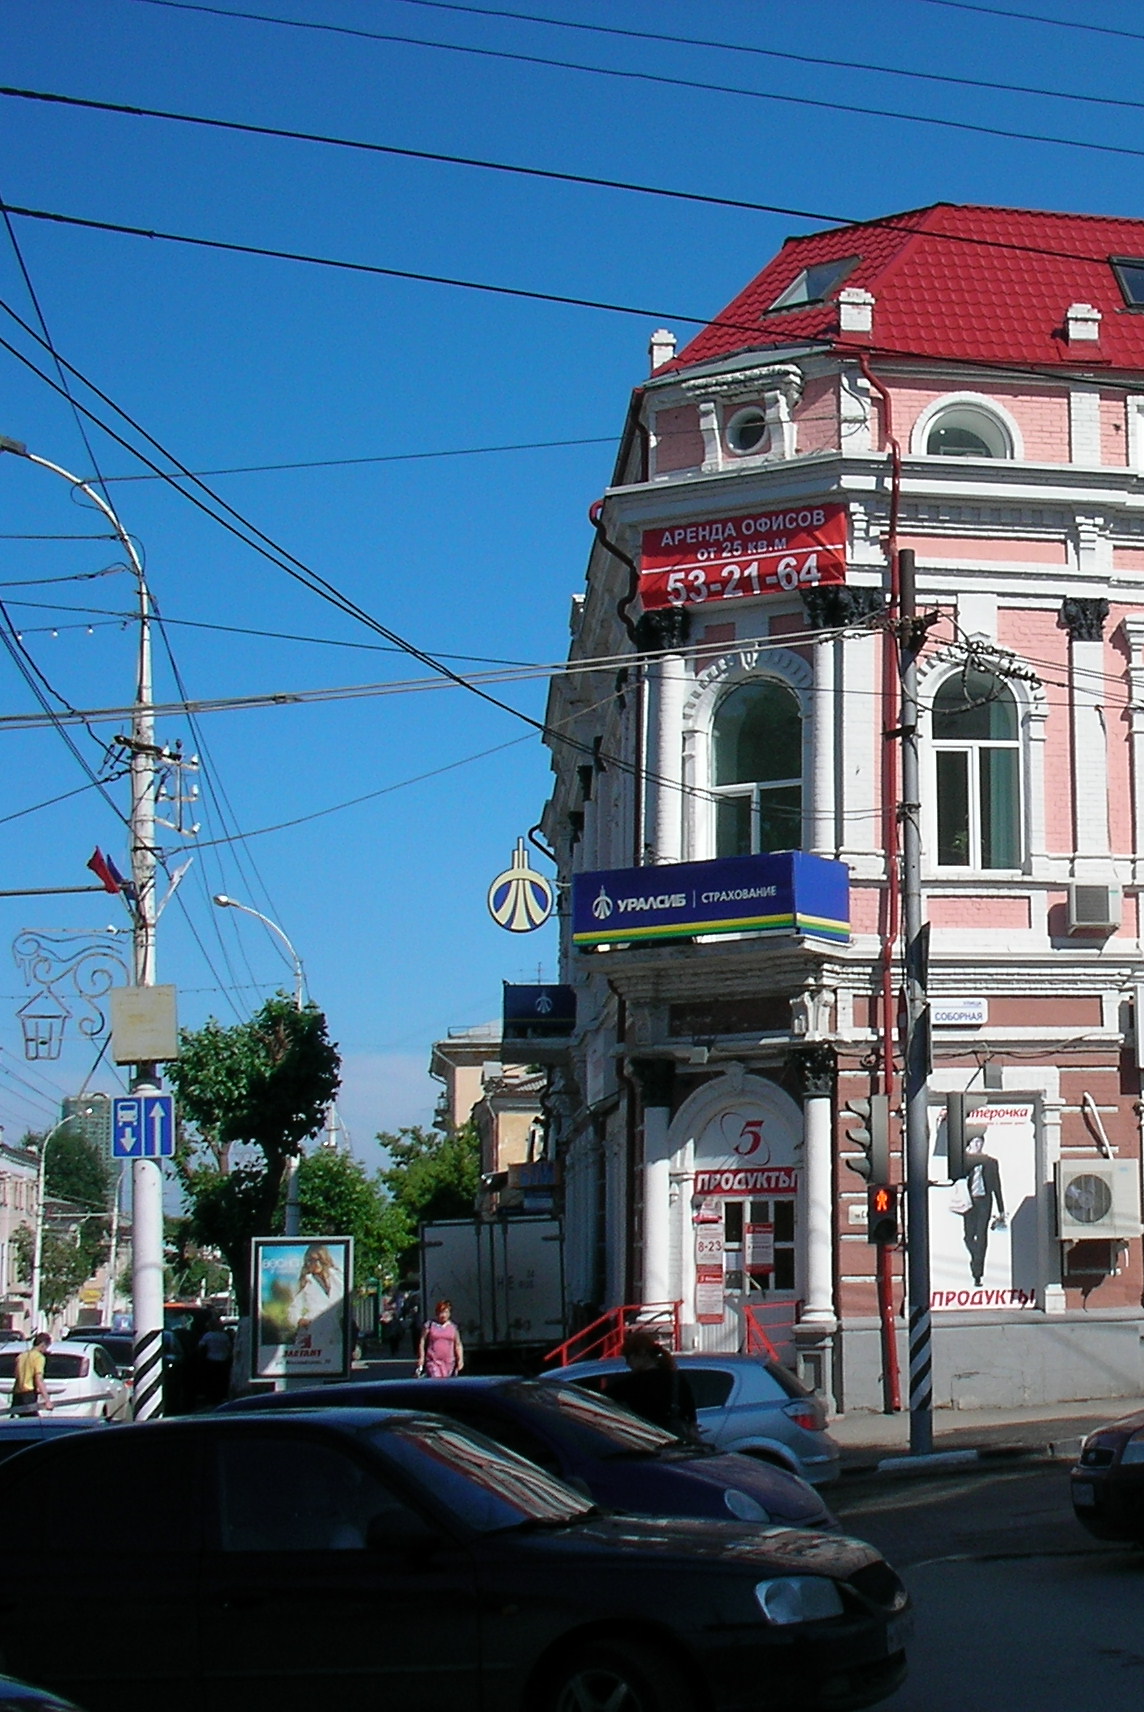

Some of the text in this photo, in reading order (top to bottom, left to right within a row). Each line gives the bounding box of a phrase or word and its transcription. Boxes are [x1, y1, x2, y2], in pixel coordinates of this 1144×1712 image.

[660, 509, 825, 547] АРЕНДА ОФИСОВ
[722, 540, 742, 558] 25
[667, 553, 822, 605] 53-21-64
[617, 885, 777, 912] УРАЛСИБ СТРАХОВАНИЕ
[935, 1012, 983, 1021] СОБОРНАЯ
[733, 1120, 764, 1156] 5
[697, 1170, 798, 1192] ПРОДУКТЫ
[698, 1240, 722, 1253] 8-23
[930, 1288, 1036, 1307] ПРОДУКТЫ
